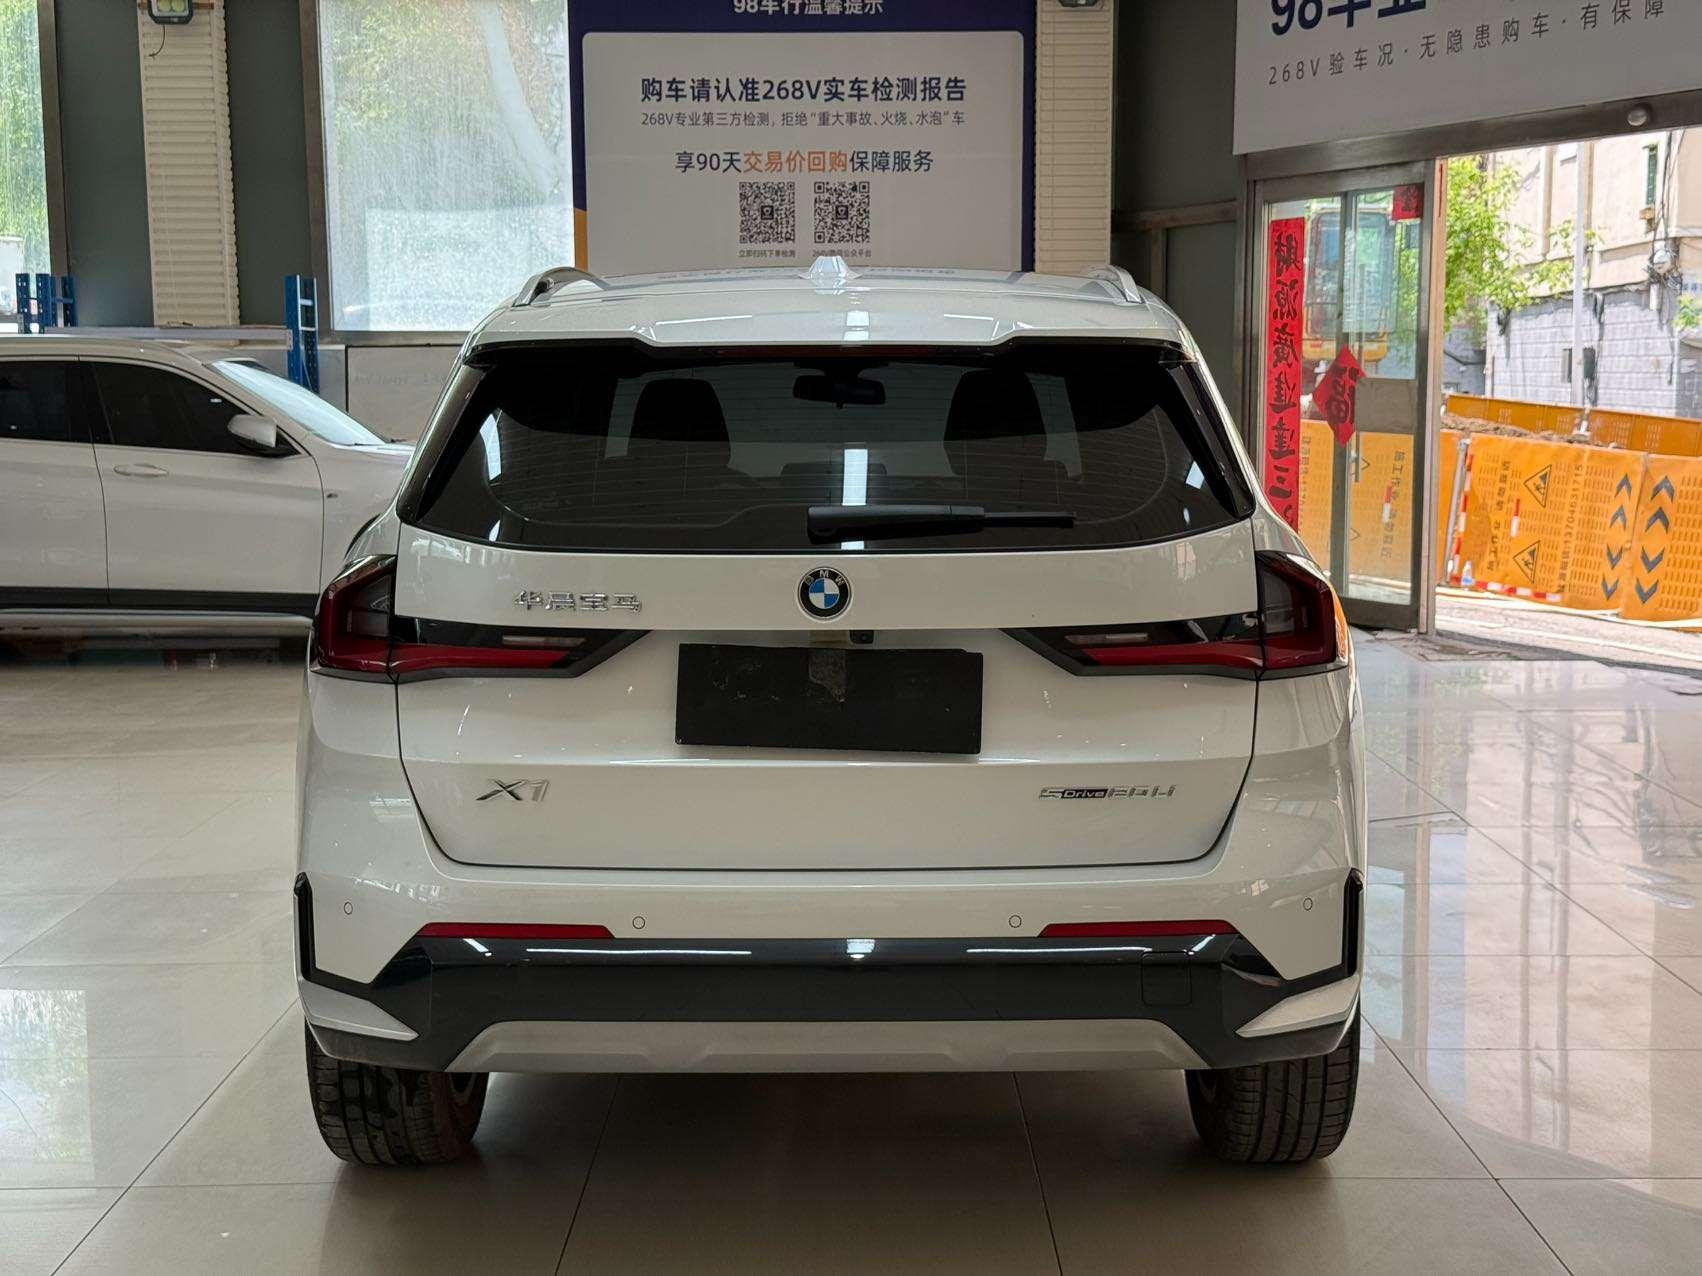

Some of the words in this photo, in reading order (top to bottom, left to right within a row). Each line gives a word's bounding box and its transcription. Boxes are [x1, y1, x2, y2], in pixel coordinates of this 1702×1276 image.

[734, 0, 884, 15] 98车行温馨提示
[640, 76, 967, 102] 购车请认准268V实车检测报告
[675, 150, 935, 174] 享90天交易价回购保障服务
[513, 589, 641, 614] 华晨宝马
[475, 779, 550, 802] X1
